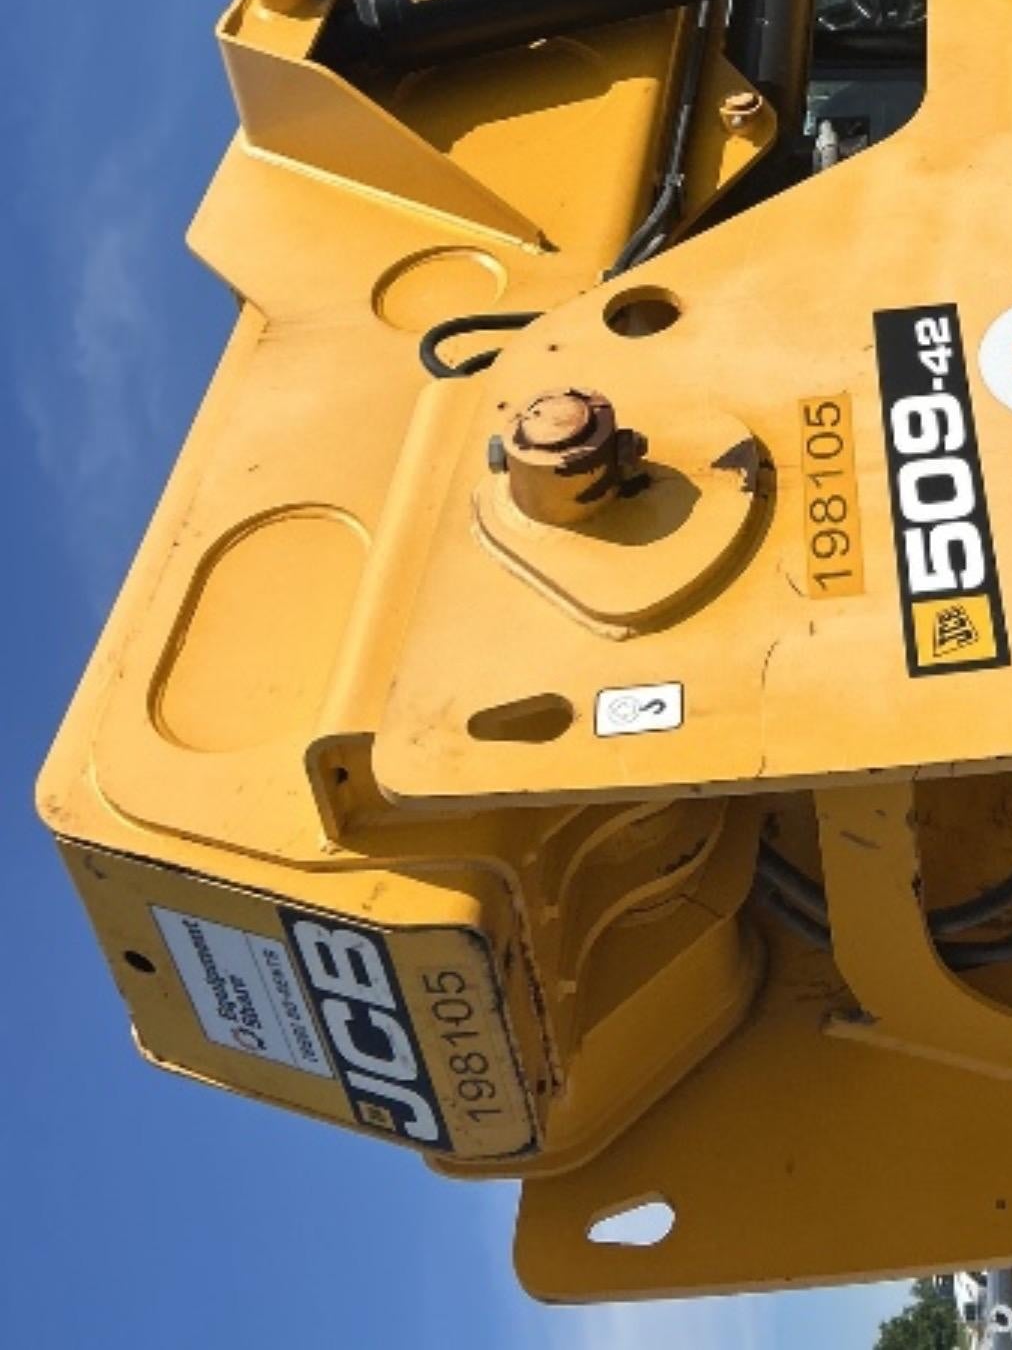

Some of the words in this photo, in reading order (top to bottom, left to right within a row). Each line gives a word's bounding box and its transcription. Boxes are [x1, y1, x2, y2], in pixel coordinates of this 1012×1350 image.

[804, 400, 854, 592] 198105
[890, 316, 987, 593] 509-42
[290, 918, 440, 1142] JCB
[421, 970, 504, 1124] 198105
